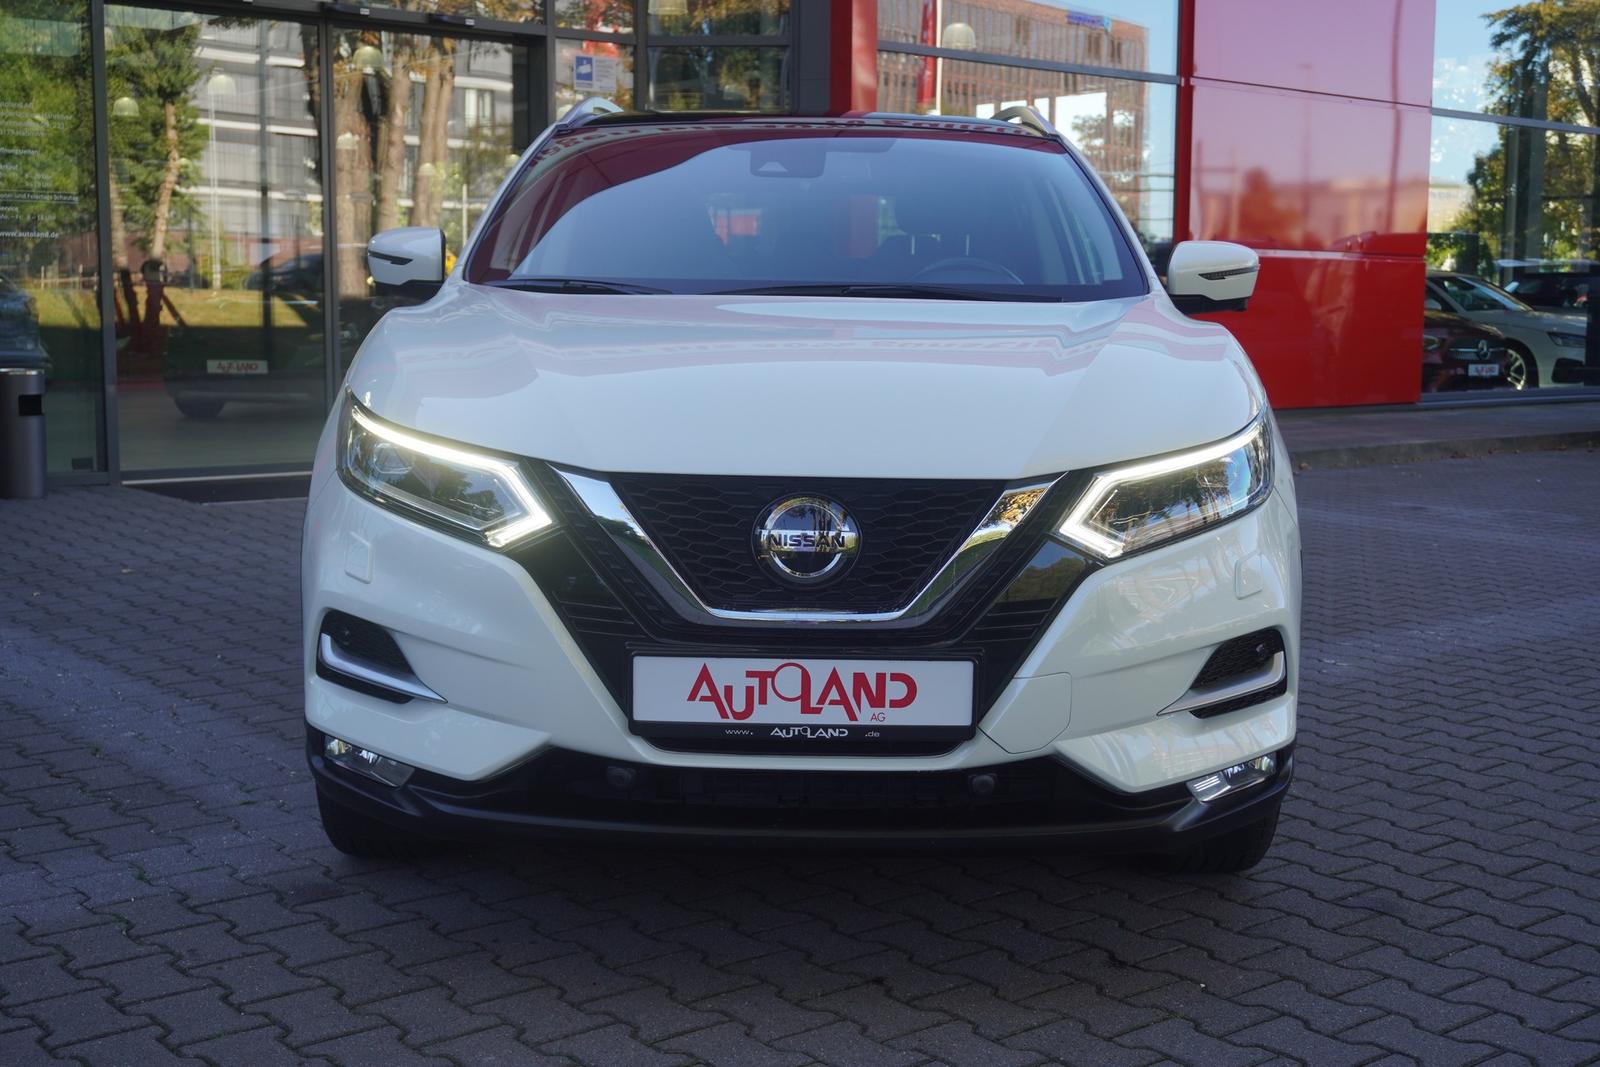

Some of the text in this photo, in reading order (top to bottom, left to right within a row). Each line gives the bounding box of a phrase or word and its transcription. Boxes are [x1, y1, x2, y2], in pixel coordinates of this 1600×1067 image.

[769, 532, 845, 549] NISSAN
[687, 662, 918, 721] AUTOLAND
[870, 712, 886, 722] AG
[770, 726, 848, 738] AUTOLAND
